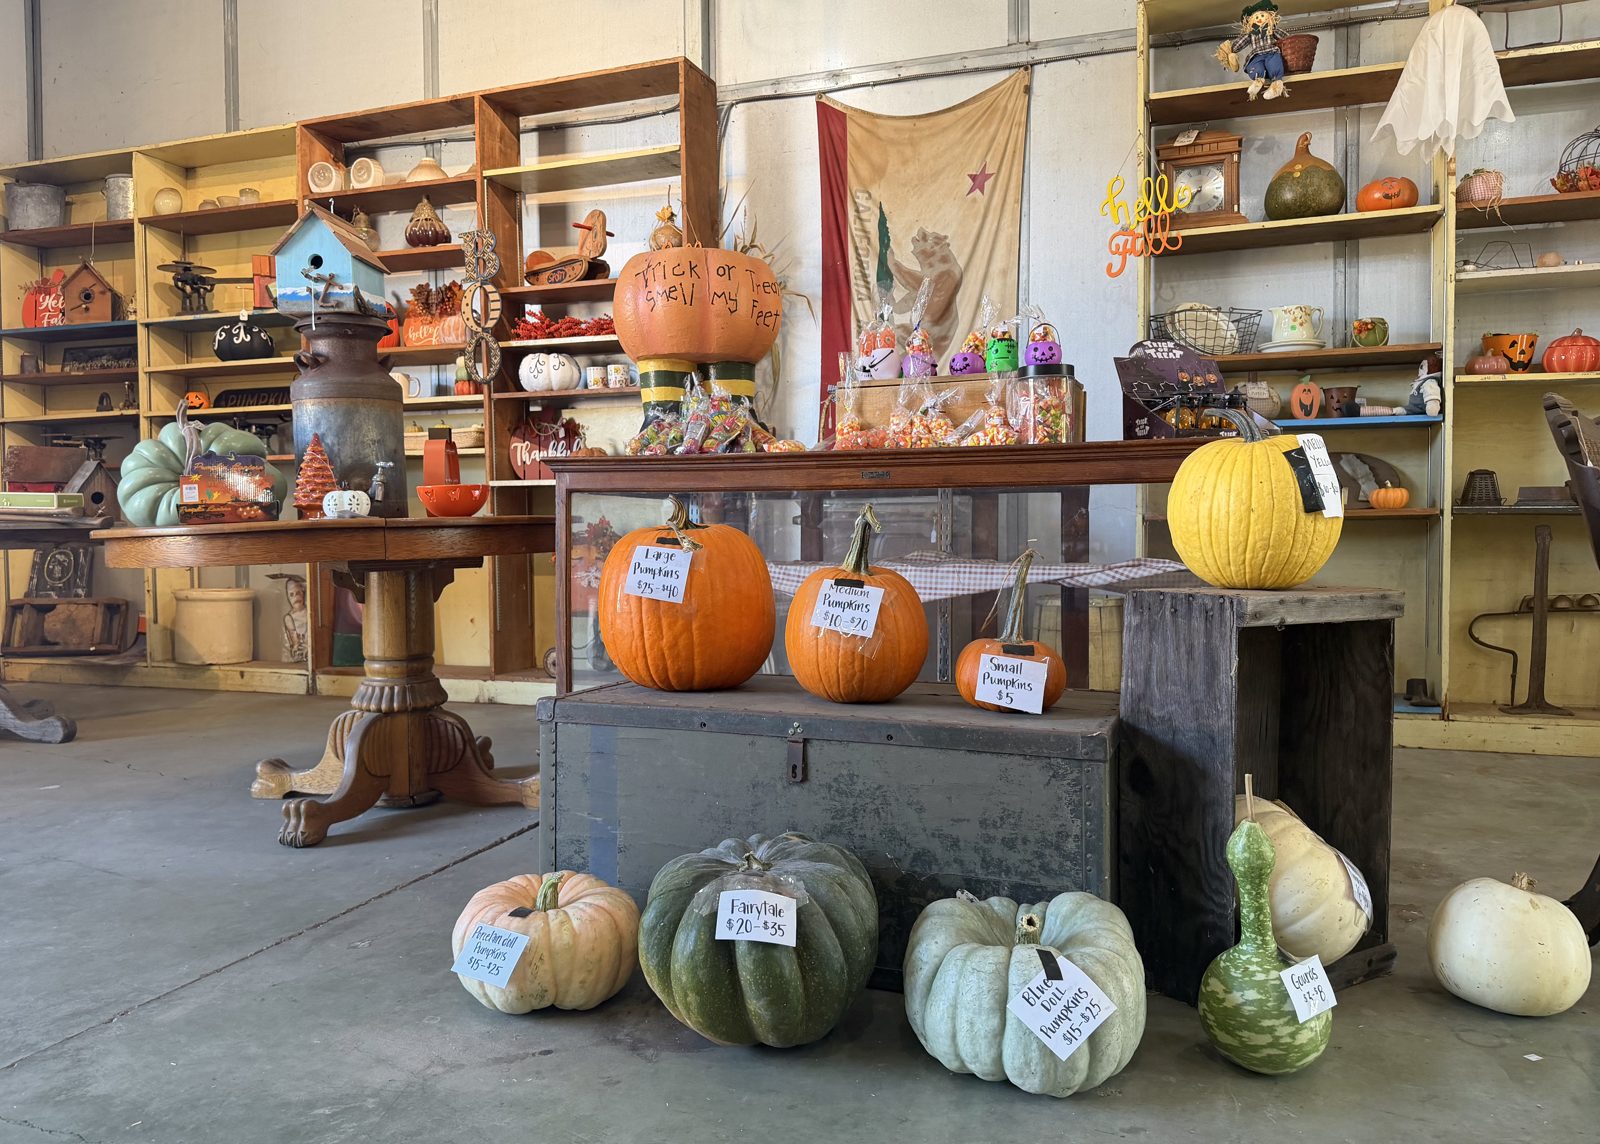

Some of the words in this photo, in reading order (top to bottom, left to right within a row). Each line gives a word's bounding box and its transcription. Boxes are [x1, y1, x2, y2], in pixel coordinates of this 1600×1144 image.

[1100, 174, 1192, 231] hello
[854, 188, 872, 301] CALIFORNIA
[716, 264, 737, 281] or
[38, 293, 66, 312] Hel
[40, 311, 66, 327] Fal
[750, 299, 780, 332] Feet
[645, 548, 677, 564] Large
[633, 561, 680, 580] Pumpkins
[829, 583, 870, 599] Medium
[823, 593, 870, 613] Pumpkins
[989, 656, 1023, 675] Small
[982, 671, 1033, 691] Pumpkins
[996, 689, 1015, 705] $5
[731, 898, 785, 920] Fairytale
[473, 941, 508, 961] Pumpkins
[1290, 965, 1319, 991] Gourds
[1021, 978, 1054, 1007] Blue
[1039, 987, 1089, 1039] Pumpkins
